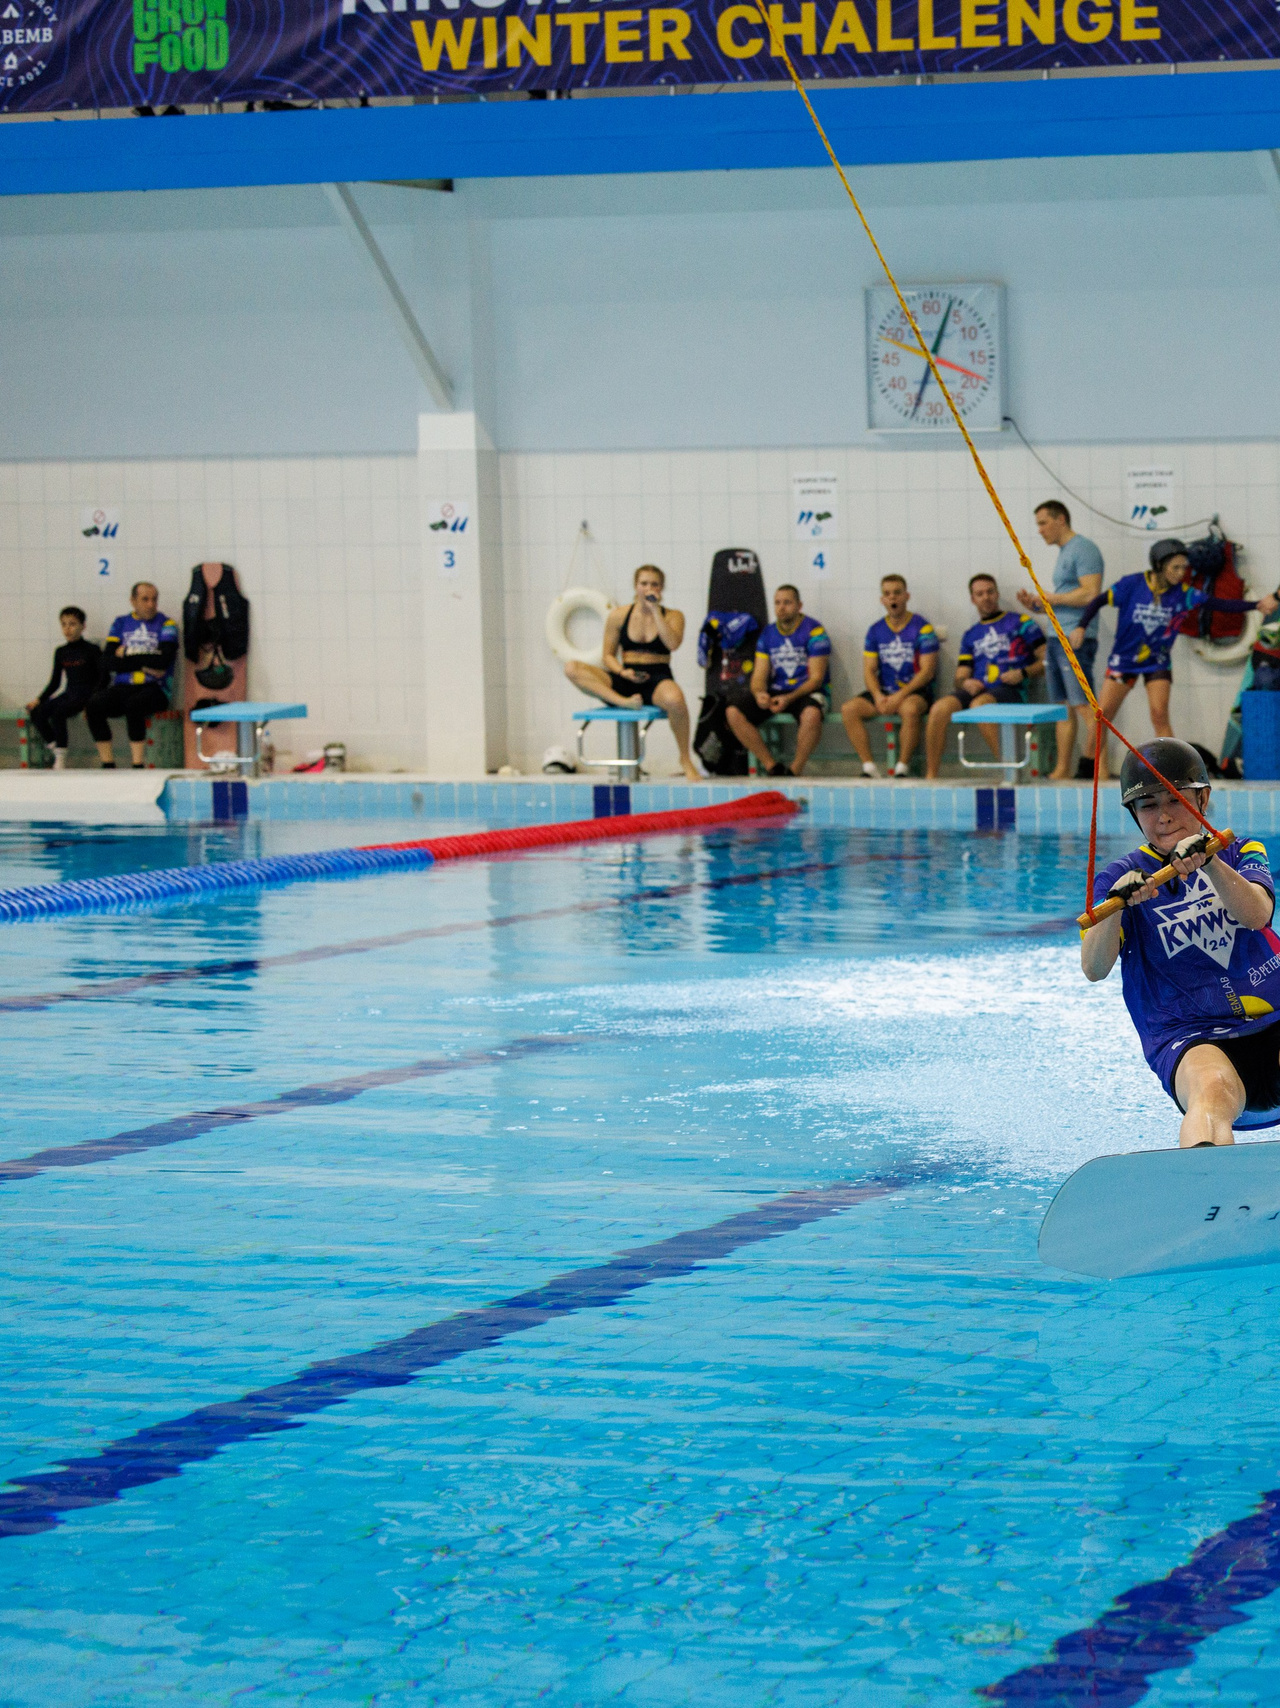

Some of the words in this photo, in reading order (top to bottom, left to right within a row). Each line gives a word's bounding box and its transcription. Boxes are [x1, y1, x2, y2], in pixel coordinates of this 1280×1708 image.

[0, 27, 53, 45] BEMB
[410, 7, 693, 72] WINTER
[716, 0, 1162, 59] CHALLENGE
[133, 18, 229, 74] FOOD
[922, 300, 941, 315] 60
[952, 310, 962, 325] 5
[886, 327, 905, 342] 50
[960, 326, 978, 340] 10
[881, 353, 900, 366] 45
[969, 350, 987, 365] 15
[888, 377, 907, 391] 40
[961, 375, 979, 389] 20
[925, 402, 944, 417] 30
[443, 550, 455, 568] 3
[812, 552, 825, 570] 4
[99, 558, 110, 576] 2
